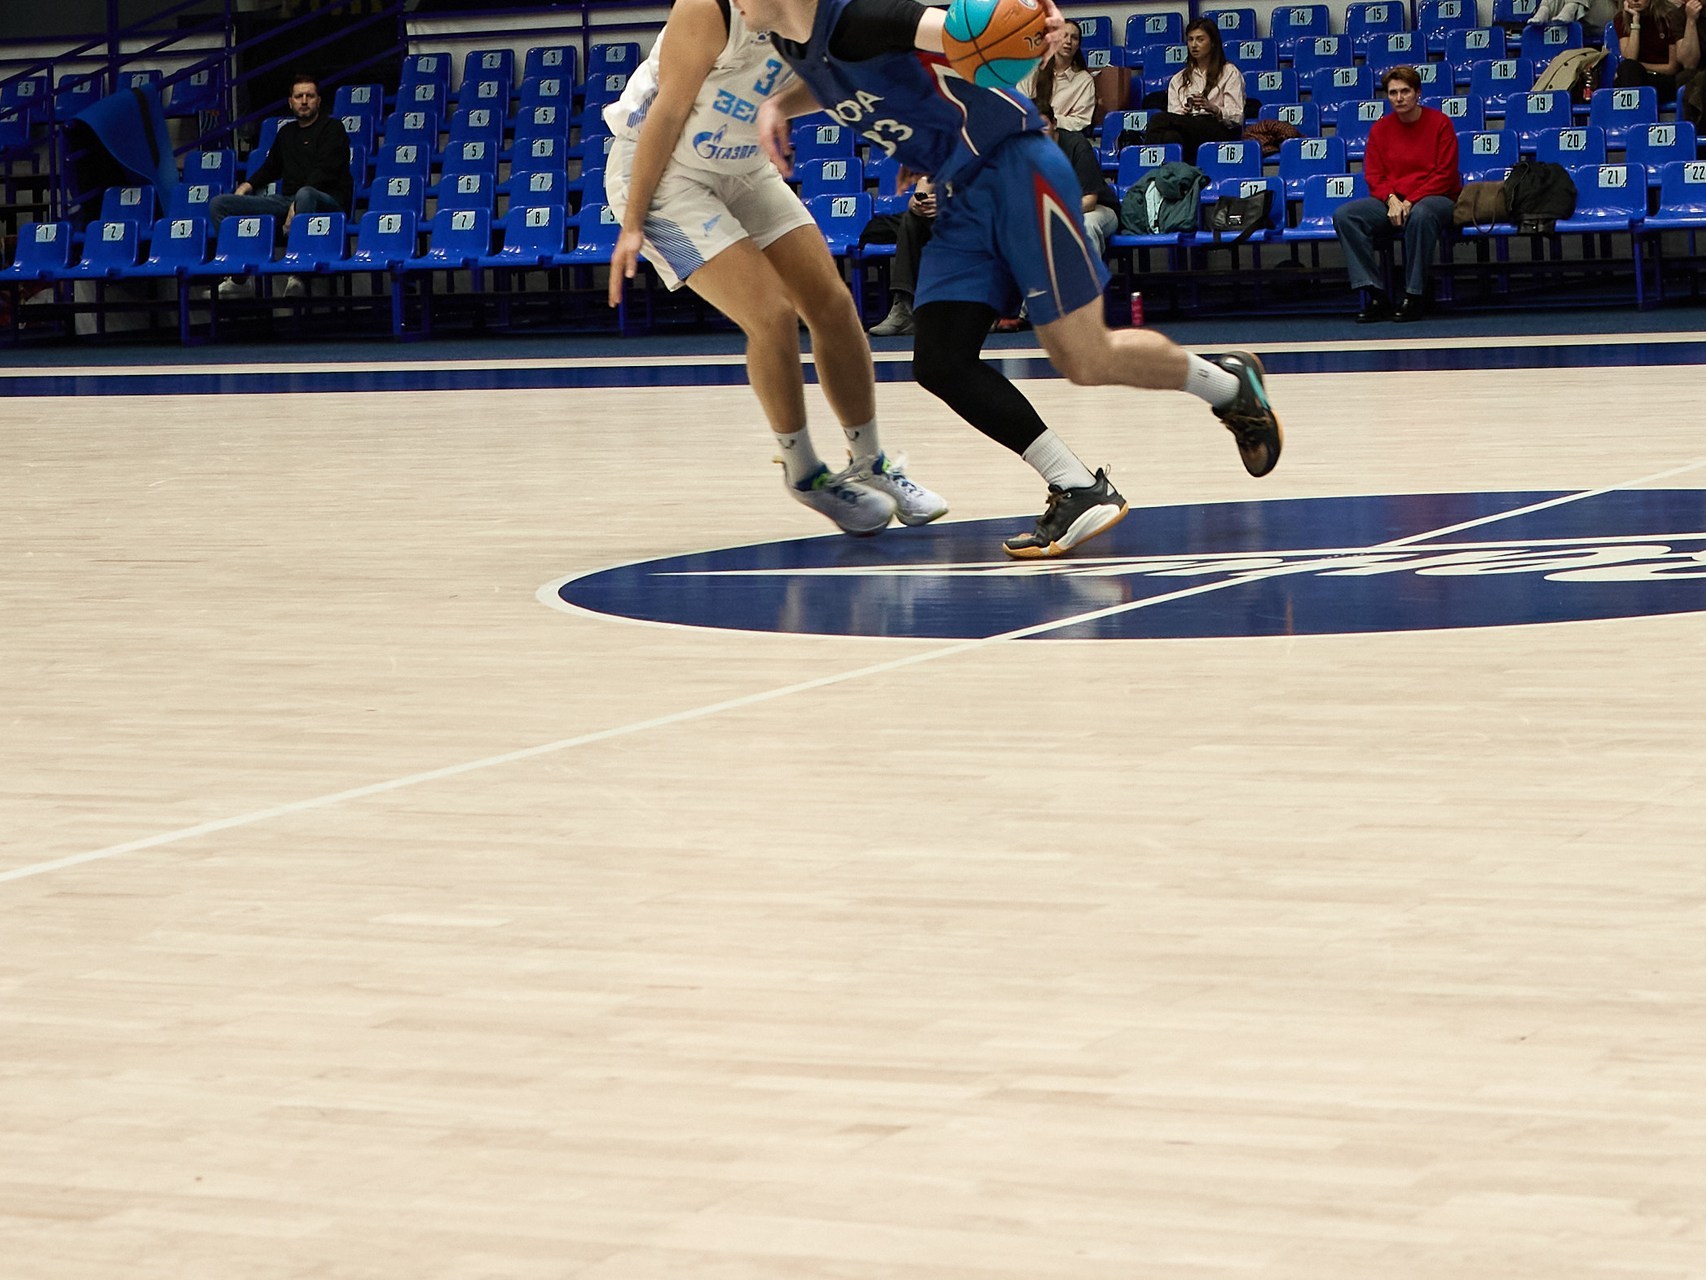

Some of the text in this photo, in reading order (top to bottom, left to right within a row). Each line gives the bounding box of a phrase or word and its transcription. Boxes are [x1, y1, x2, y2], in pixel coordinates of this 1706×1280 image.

[1445, 3, 1454, 16] 16
[1520, 0, 1529, 12] 17
[1296, 11, 1305, 23] 14
[1373, 8, 1381, 20] 15
[1152, 19, 1160, 31] 12
[1225, 15, 1233, 27] 13
[1081, 21, 1090, 34] 11
[1474, 34, 1483, 46] 17
[1551, 29, 1560, 42] 18
[1322, 40, 1331, 52] 15
[1395, 36, 1404, 49] 16
[613, 49, 618, 59] 4
[1173, 48, 1182, 61] 13
[1246, 44, 1255, 57] 14
[489, 55, 494, 67] 2
[551, 52, 556, 63] 3
[1095, 53, 1104, 65] 12
[426, 59, 430, 70] 1
[1499, 64, 1508, 77] 18
[1341, 71, 1350, 84] 16
[1420, 68, 1429, 81] 17
[547, 82, 552, 93] 4
[614, 77, 619, 89] 5
[1266, 75, 1275, 88] 15
[360, 89, 363, 100] 1
[422, 87, 427, 99] 2
[486, 84, 491, 95] 3
[712, 88, 759, 124] ЗЕ
[1536, 97, 1545, 111] 19
[1621, 93, 1632, 107] 20
[1367, 105, 1376, 118] 17
[1449, 102, 1459, 115] 18
[412, 115, 418, 127] 3
[477, 113, 482, 124] 4
[543, 109, 548, 121] 5
[1286, 109, 1295, 122] 16
[348, 118, 353, 130] 2
[1131, 115, 1139, 128] 14
[824, 129, 832, 142] 10
[1567, 134, 1579, 148] 20
[1657, 129, 1668, 143] 21
[540, 142, 545, 154] 6
[1310, 143, 1319, 157] 17
[1482, 138, 1492, 151] 19
[403, 149, 409, 160] 4
[472, 145, 477, 157] 5
[716, 144, 760, 160] ГАЗПР
[1148, 150, 1157, 163] 15
[1226, 147, 1235, 160] 16
[210, 154, 214, 166] 1
[830, 164, 838, 177] 11
[1692, 165, 1705, 180] 22
[539, 176, 545, 189] 7
[1607, 170, 1618, 184] 21
[397, 181, 402, 193] 5
[466, 178, 472, 190] 6
[1335, 181, 1344, 195] 18
[129, 190, 133, 202] 1
[195, 188, 201, 200] 2
[839, 201, 848, 214] 12
[387, 218, 393, 230] 6
[461, 215, 467, 228] 7
[535, 212, 540, 224] 8
[111, 226, 116, 238] 2
[180, 223, 185, 235] 3
[246, 221, 252, 234] 4
[316, 220, 322, 232] 5
[44, 227, 49, 239] 1
